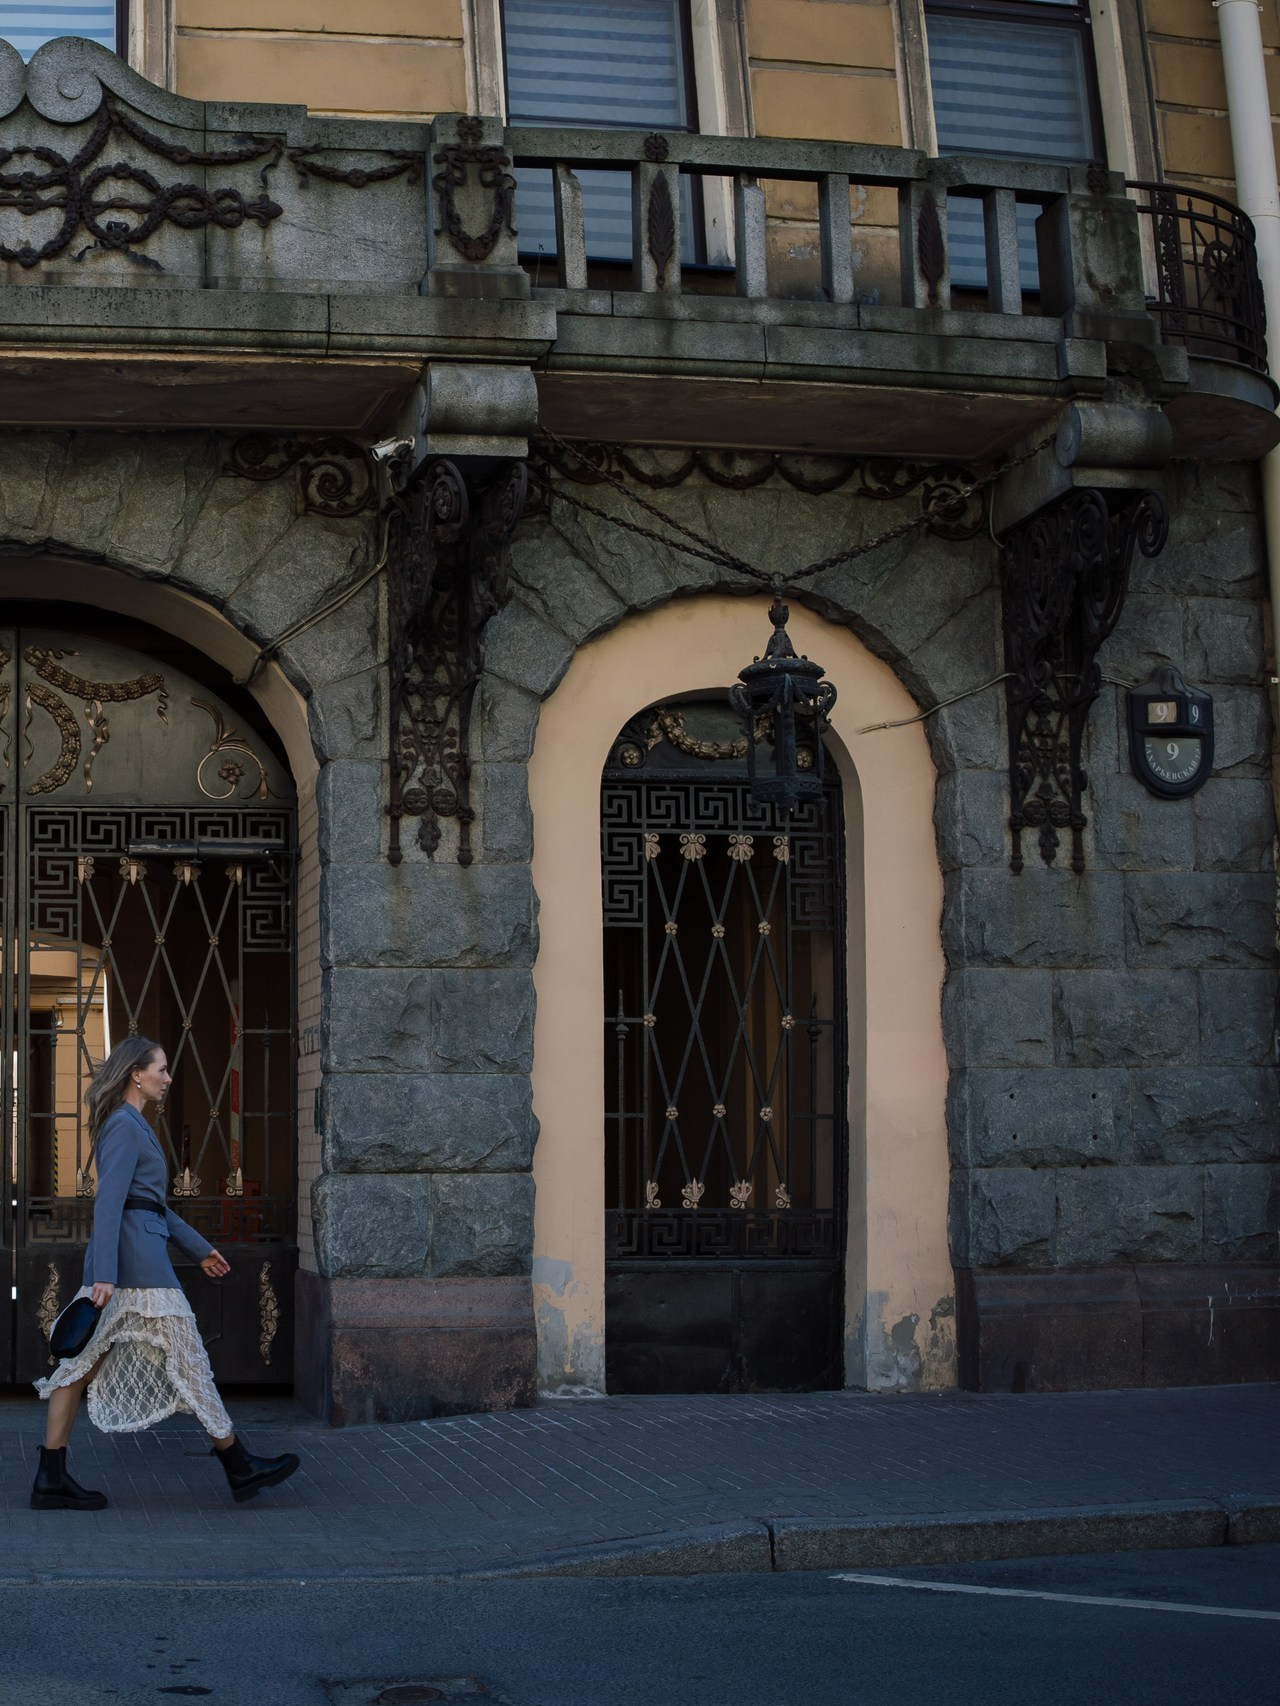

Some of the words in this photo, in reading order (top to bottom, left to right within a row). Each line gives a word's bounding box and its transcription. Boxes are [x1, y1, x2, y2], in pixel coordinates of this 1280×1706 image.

[1156, 704, 1168, 721] 9
[1192, 705, 1199, 723] 9
[1166, 742, 1179, 761] 9
[1145, 742, 1198, 780] ЗАХАРЬЕВСКАЯ
